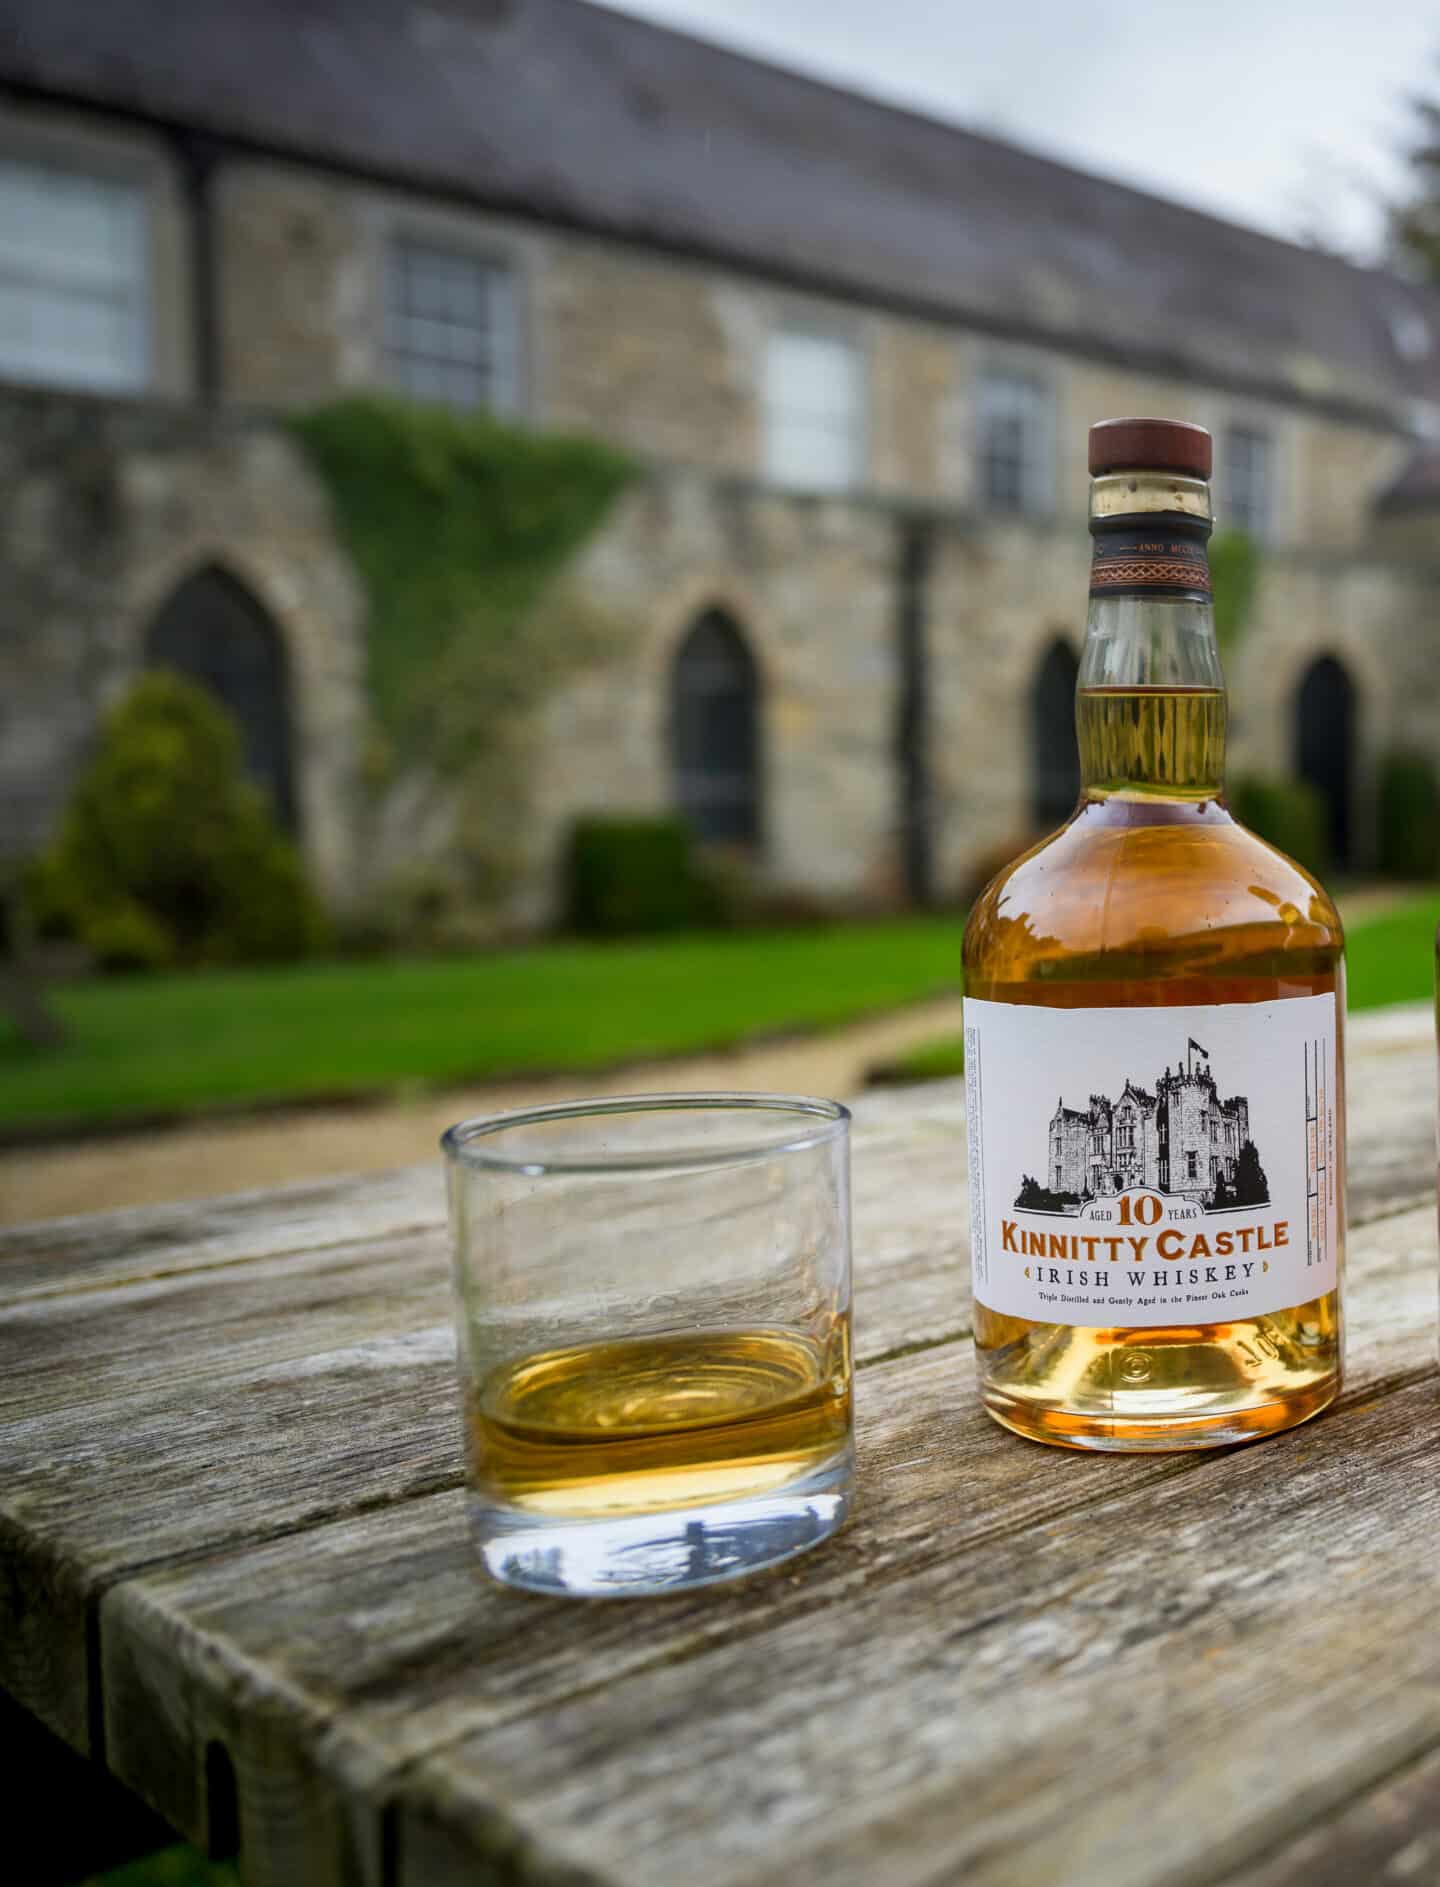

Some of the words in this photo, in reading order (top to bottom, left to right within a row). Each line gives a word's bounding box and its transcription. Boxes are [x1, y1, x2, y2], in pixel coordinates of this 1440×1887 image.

[1089, 1210, 1112, 1222] AGED
[1116, 1194, 1163, 1226] 10
[1168, 1208, 1198, 1221] YEARS
[1001, 1219, 1149, 1262] KINNITTY
[1156, 1220, 1289, 1261] CASTLE
[1036, 1266, 1109, 1287] IRISH
[1127, 1262, 1256, 1287] WHISKEY
[1038, 1291, 1059, 1303] Triple
[1060, 1293, 1090, 1304] Distilled
[1092, 1296, 1105, 1305] and
[1108, 1296, 1134, 1307] Gently
[1137, 1296, 1156, 1306] Aged
[1160, 1297, 1168, 1305] in
[1170, 1295, 1183, 1304] the
[1211, 1290, 1227, 1300] Oak
[1229, 1287, 1250, 1298] Casks
